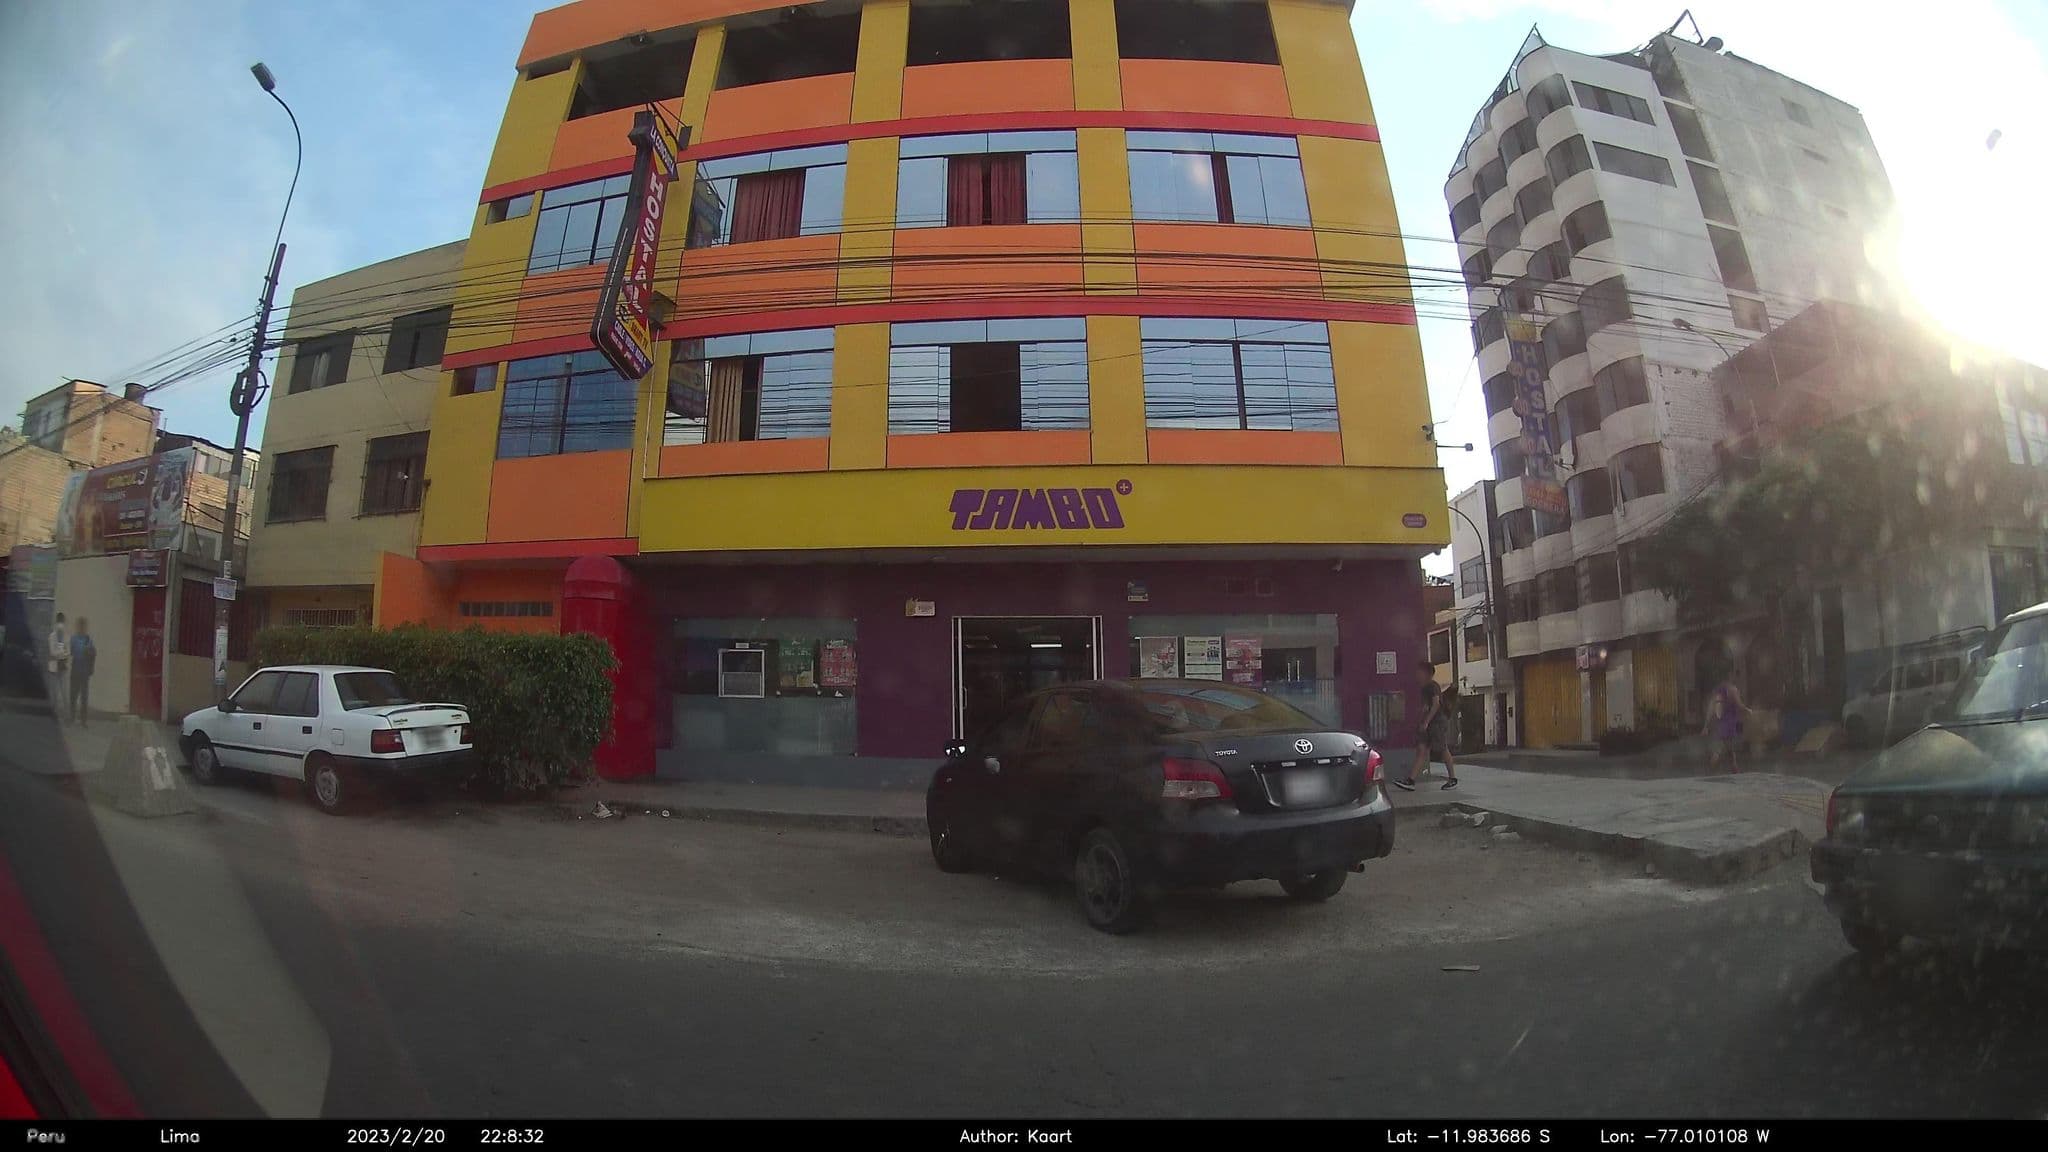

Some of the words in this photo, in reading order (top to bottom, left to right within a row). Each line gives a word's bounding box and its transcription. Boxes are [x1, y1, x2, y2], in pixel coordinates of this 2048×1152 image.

[632, 172, 664, 314] HOSTAL
[1521, 344, 1553, 477] HOSTAL
[949, 488, 1125, 530] TAMBO
[1215, 749, 1238, 757] TOYOTA
